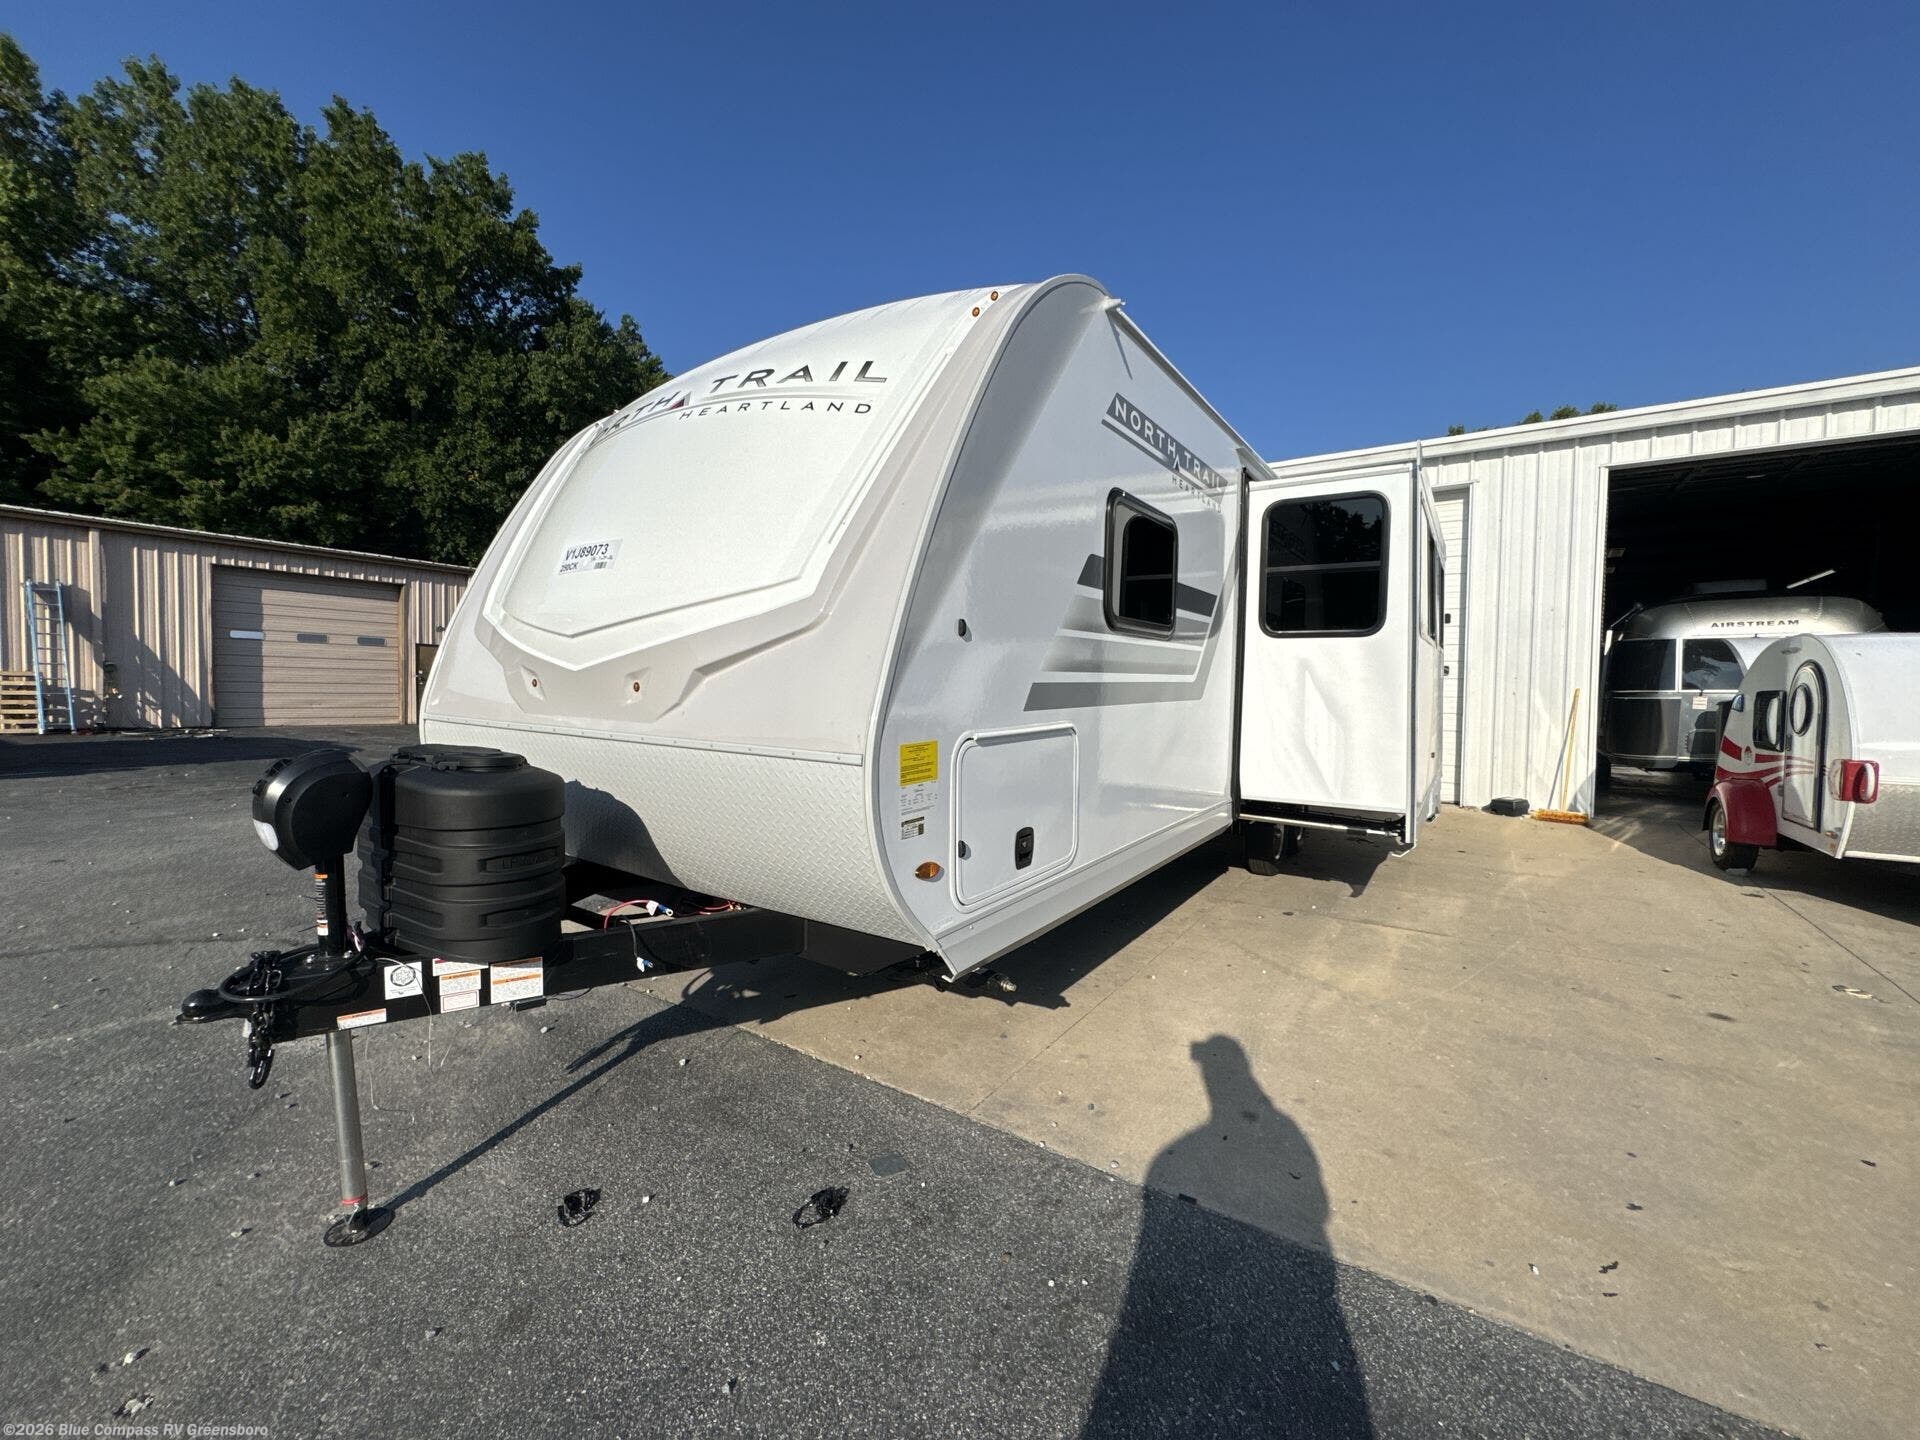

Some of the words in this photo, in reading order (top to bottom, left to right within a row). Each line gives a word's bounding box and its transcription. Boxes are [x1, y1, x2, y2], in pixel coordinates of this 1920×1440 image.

[709, 360, 887, 393] TRAIL
[678, 400, 872, 420] HEARTLAND
[1115, 397, 1176, 458] NORTH
[1184, 452, 1223, 493] TRAIL
[1711, 620, 1799, 628] AIRSTREAM
